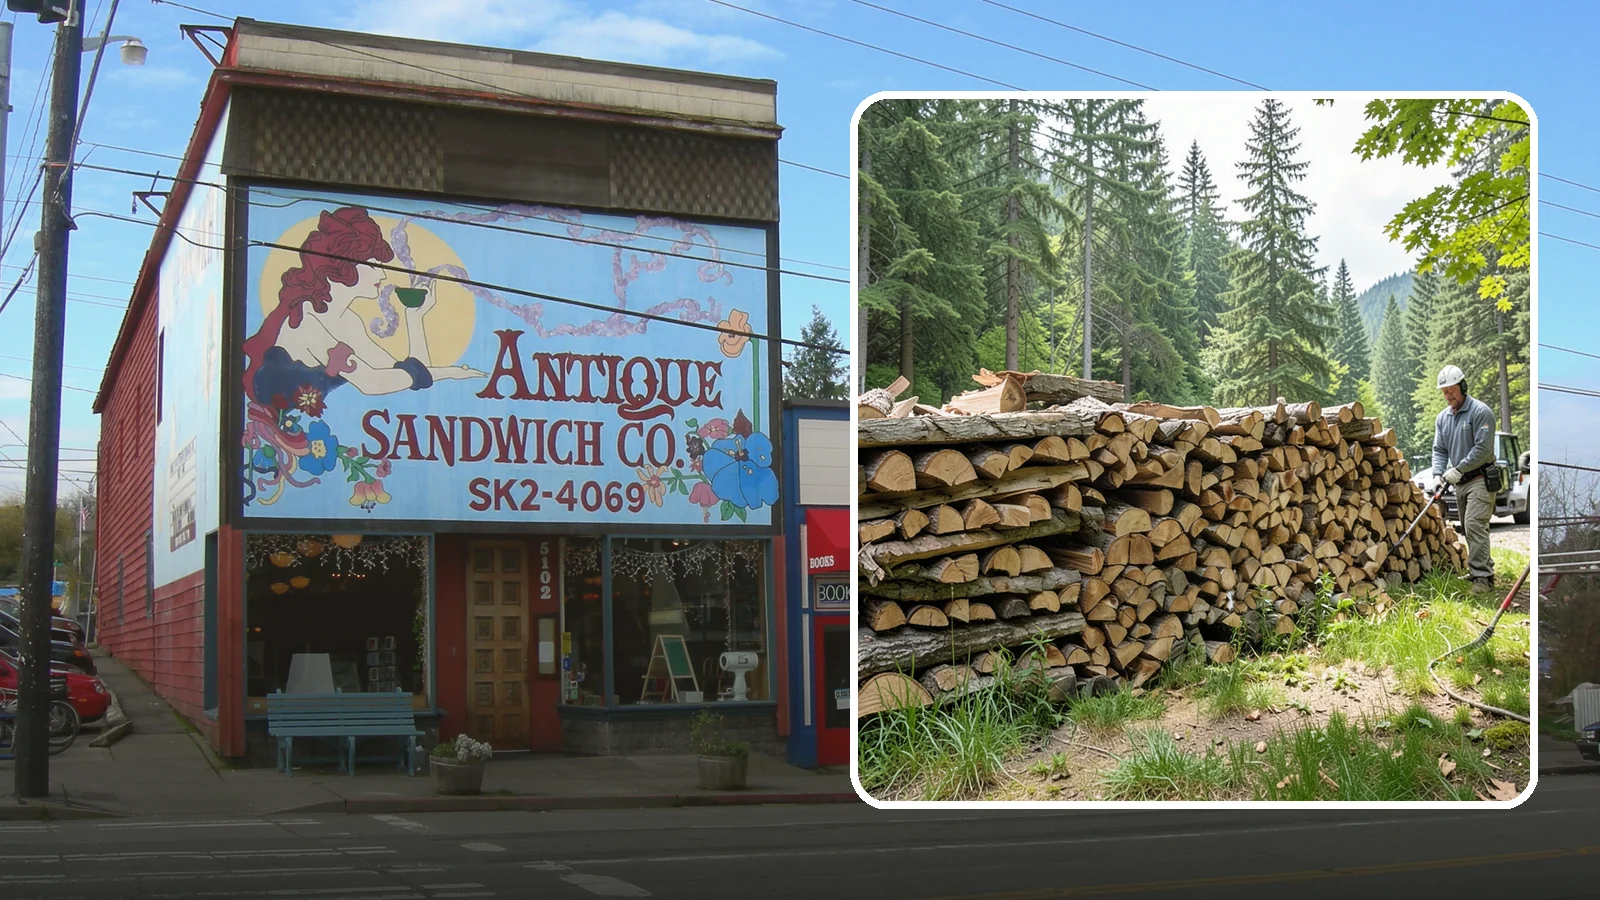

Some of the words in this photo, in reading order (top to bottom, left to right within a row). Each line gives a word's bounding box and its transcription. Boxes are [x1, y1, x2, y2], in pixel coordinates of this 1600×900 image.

[361, 408, 605, 467] SANDWICH
[617, 422, 685, 470] CO.
[468, 477, 646, 513] SK2-4069
[539, 541, 552, 599] 5102
[809, 555, 835, 568] BOOKS
